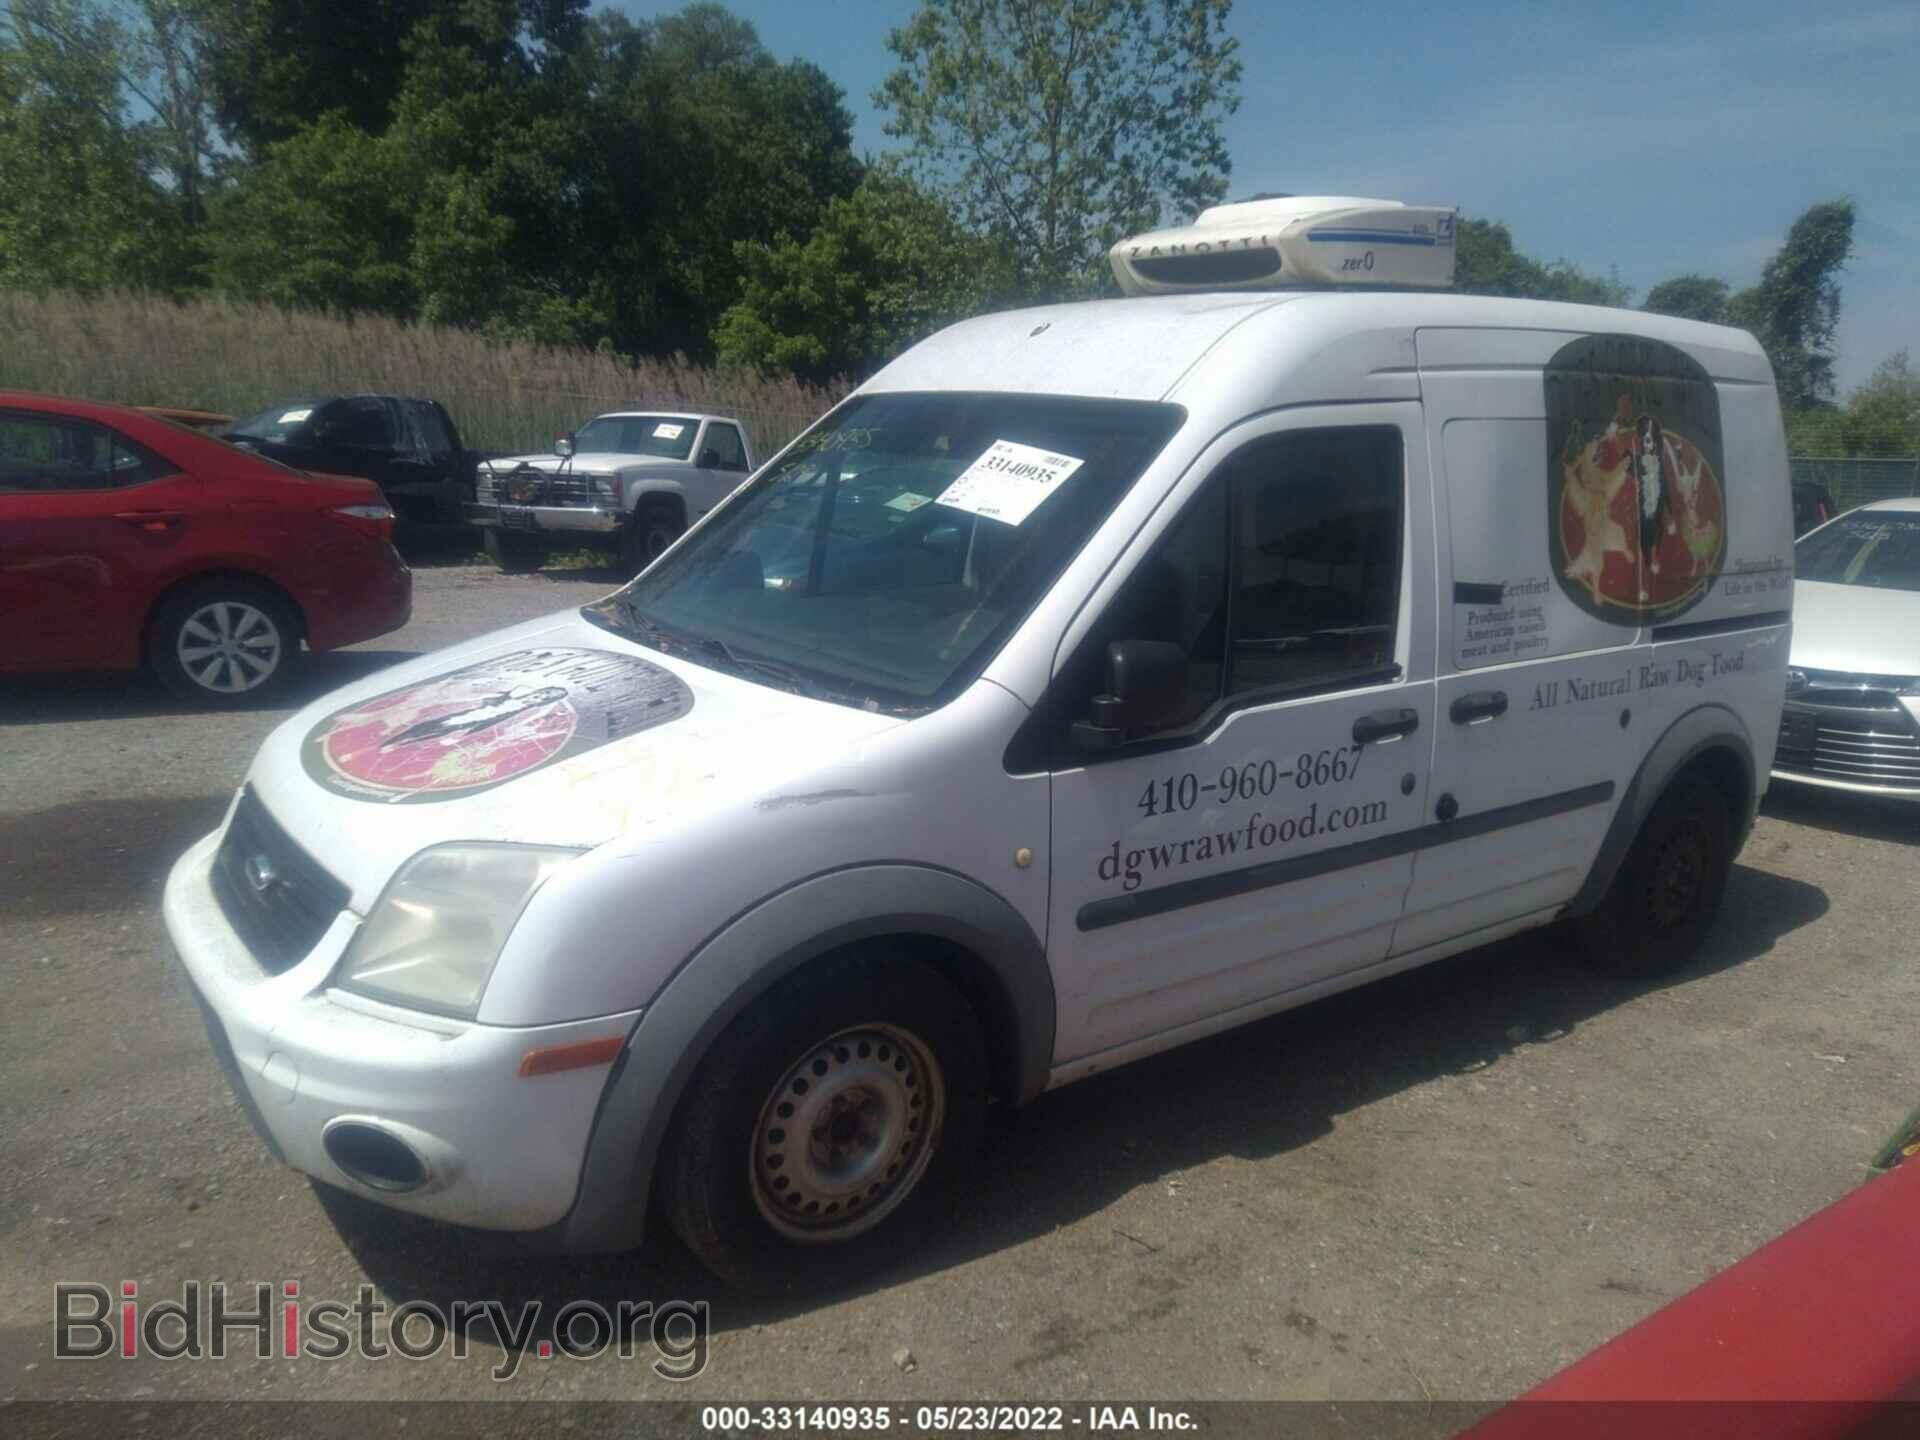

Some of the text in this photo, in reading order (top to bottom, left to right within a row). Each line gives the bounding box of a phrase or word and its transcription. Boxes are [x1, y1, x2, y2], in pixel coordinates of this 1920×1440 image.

[1130, 235, 1268, 257] ZANOTTI
[980, 455, 1057, 484] 33140935
[1529, 682, 1559, 711] All
[1565, 668, 1632, 704] Natural
[1639, 663, 1672, 690] Raw
[1676, 658, 1707, 689] Dog
[1137, 744, 1365, 817] 410-960-8667
[1097, 800, 1388, 892] dgwrawfood.com
